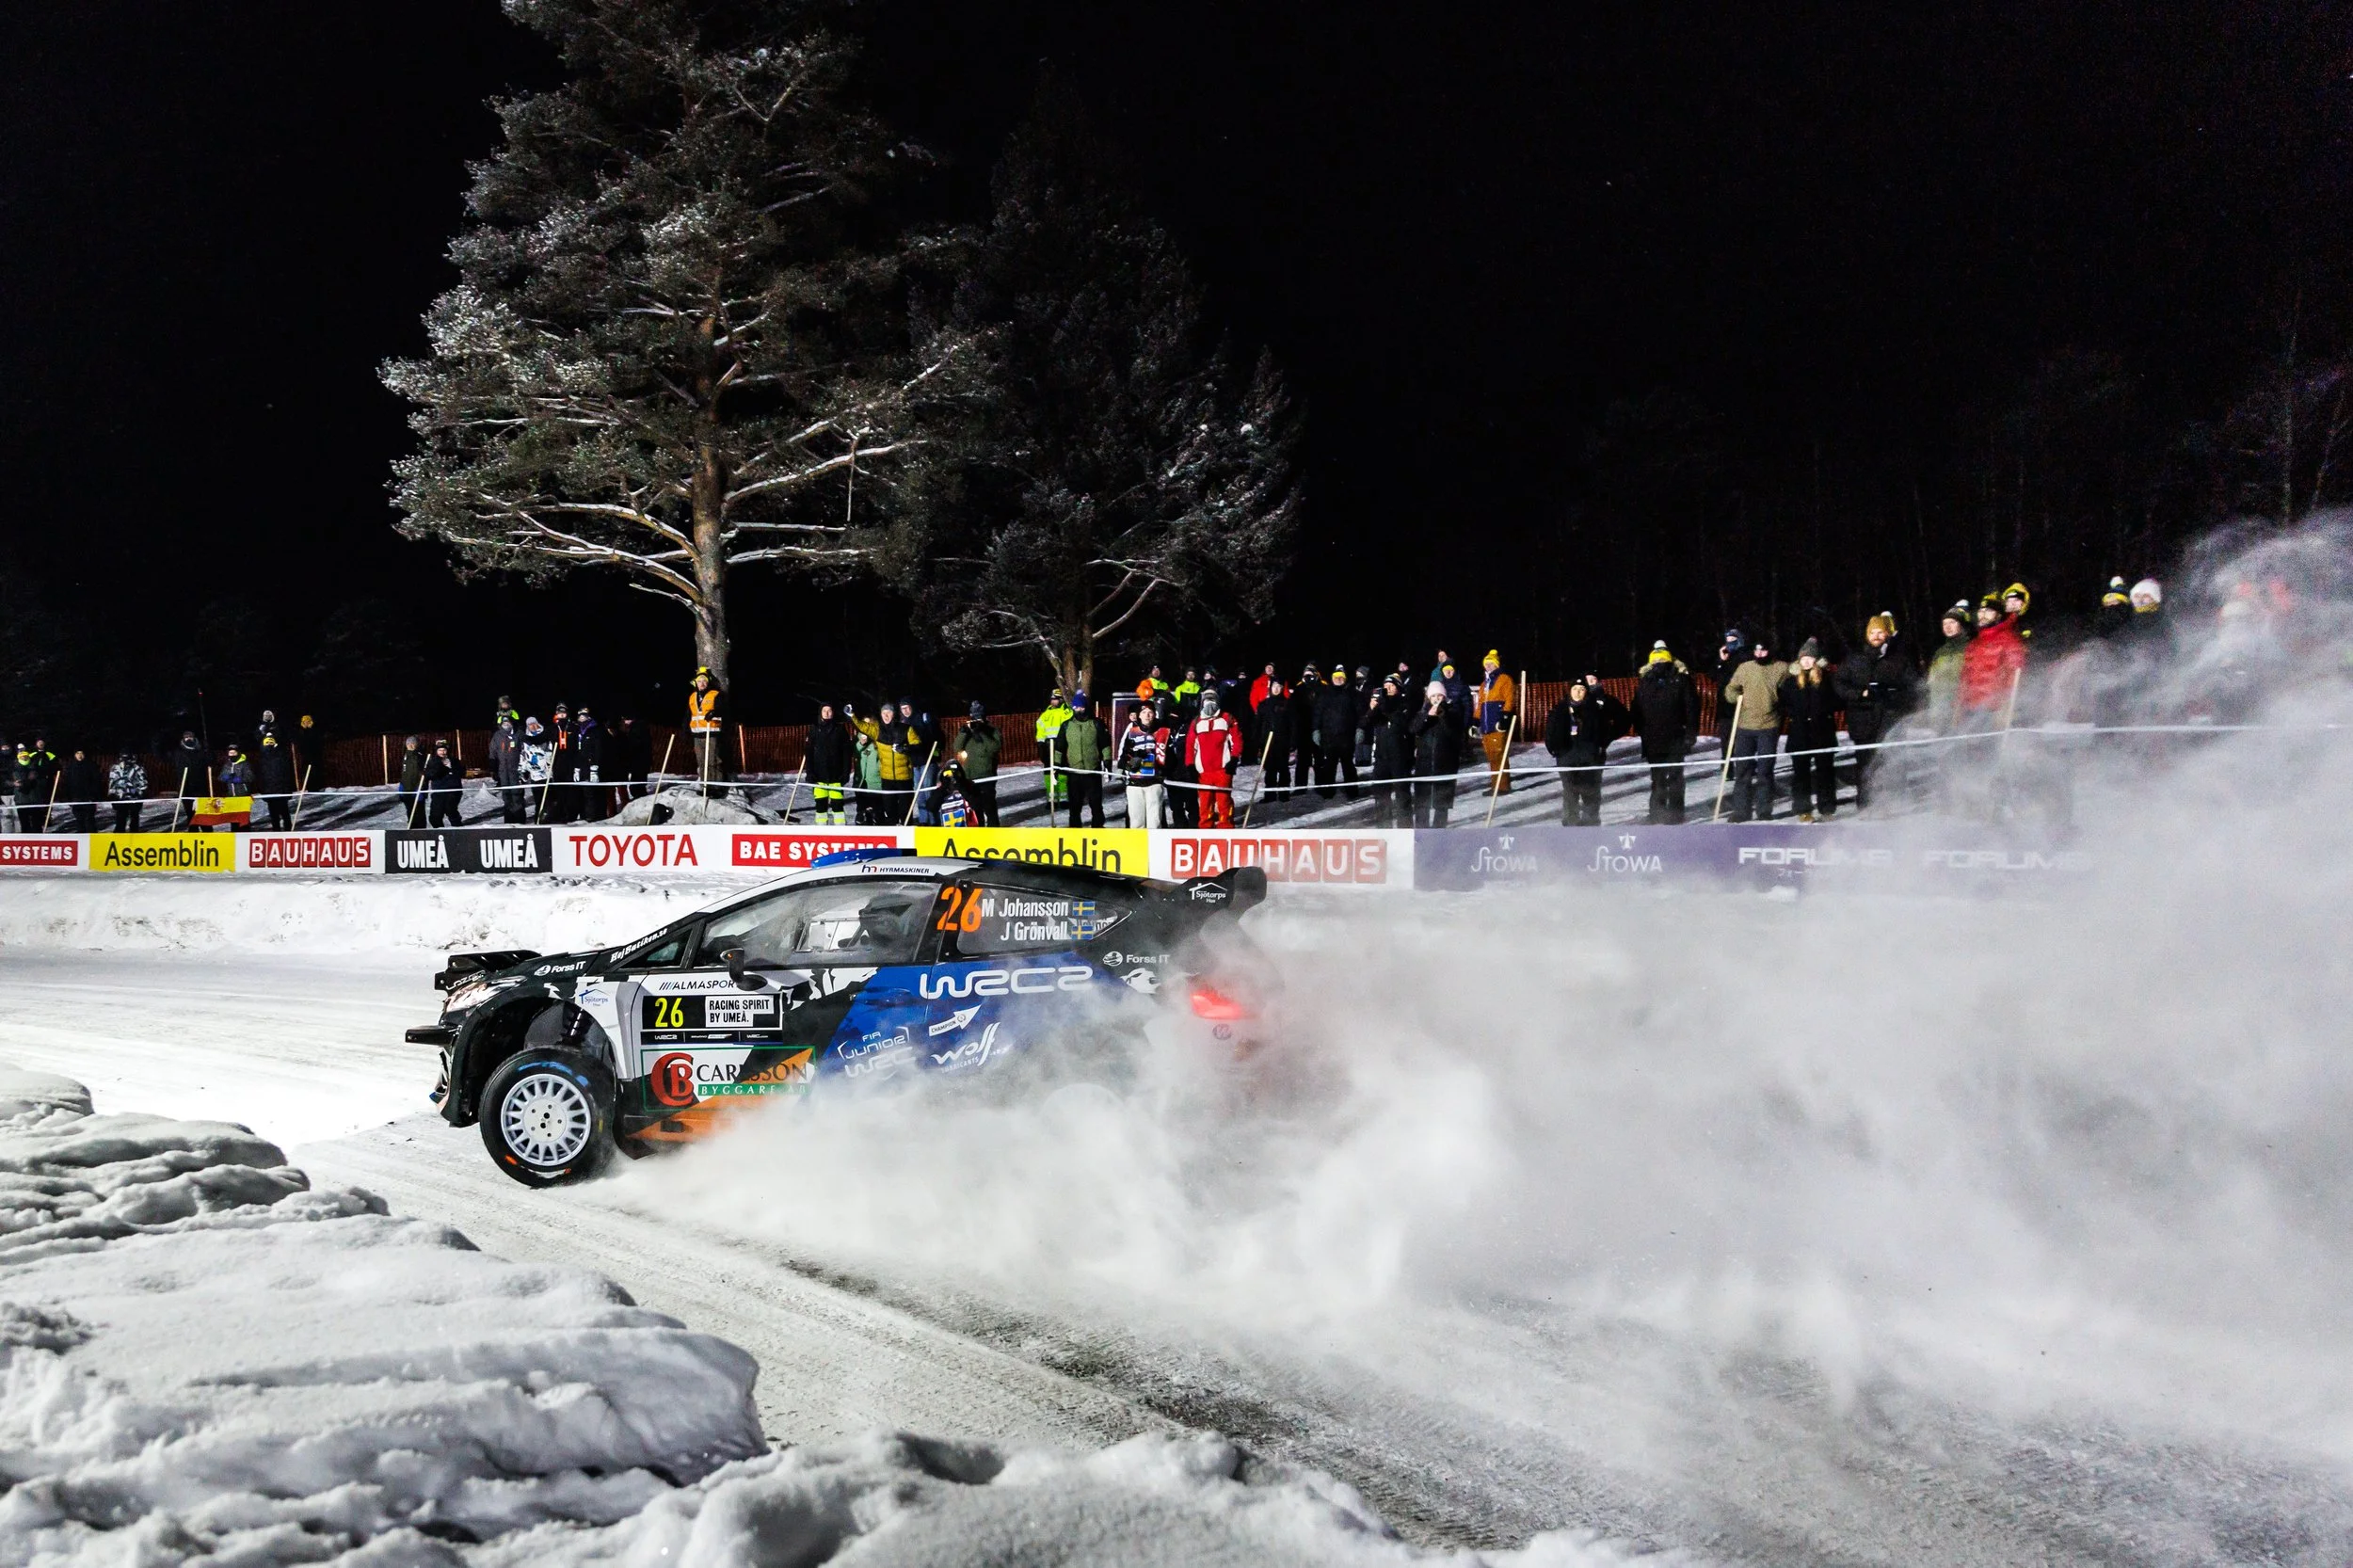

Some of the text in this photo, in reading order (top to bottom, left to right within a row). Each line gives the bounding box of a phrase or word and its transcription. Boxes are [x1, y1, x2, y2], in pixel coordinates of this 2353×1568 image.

[2, 845, 73, 860] SYSTEMS
[104, 840, 219, 867] Assemblin
[250, 840, 369, 864] BAUHAUS
[397, 835, 449, 868] UMEÅ
[480, 834, 538, 868] UMEÅ
[568, 833, 698, 867] TOYOTA
[740, 840, 889, 860] BAE SYST
[1174, 843, 1382, 876] BAUHAUS
[936, 885, 984, 933] 26
[981, 898, 1069, 919] M Johansson
[1000, 923, 1011, 942] J
[1014, 920, 1068, 942] Grönvall
[551, 960, 586, 973] Forss IT
[1127, 954, 1171, 964] Forss IT
[672, 979, 737, 991] ALMASPOR
[654, 997, 685, 1028] 26
[709, 999, 770, 1011] RACING SPIRIT
[710, 1010, 749, 1023] BY UMEÅ.
[931, 1020, 957, 1033] CHAMPION
[845, 1035, 905, 1059] JUNIOR
[862, 1032, 881, 1042] FIA
[696, 1063, 809, 1081] CARSON
